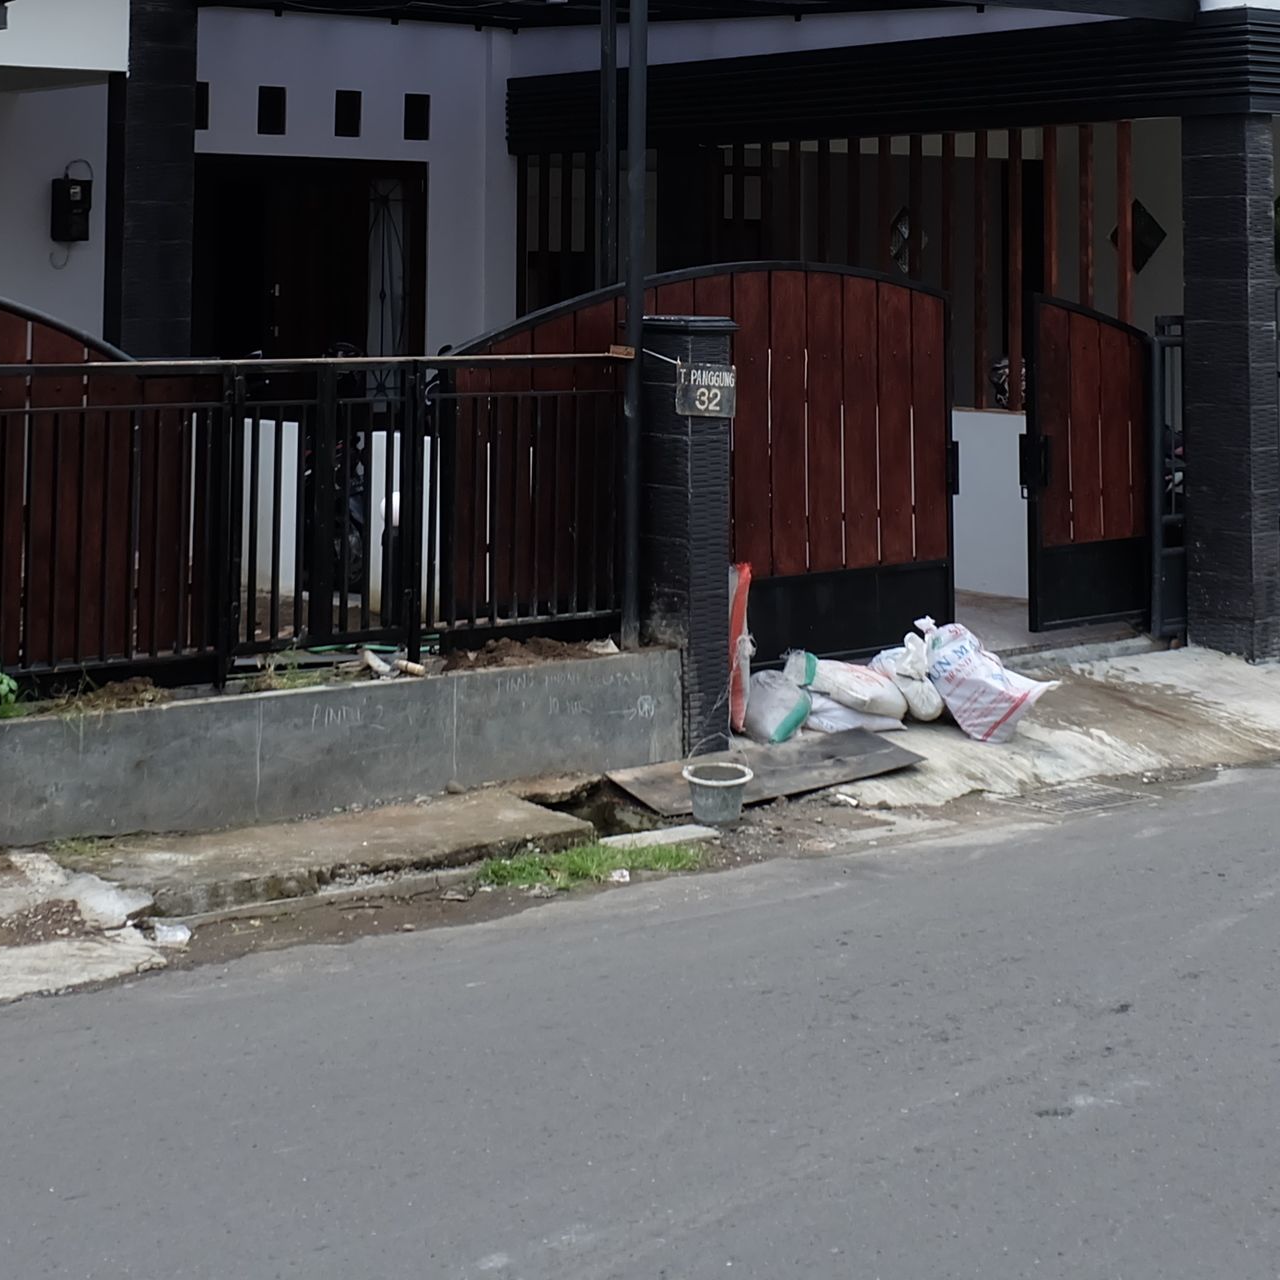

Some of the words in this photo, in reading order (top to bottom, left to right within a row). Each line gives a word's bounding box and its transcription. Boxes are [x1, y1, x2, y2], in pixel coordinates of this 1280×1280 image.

[680, 368, 688, 385] T.
[690, 369, 735, 387] PANGGUNG
[695, 387, 721, 411] 32
